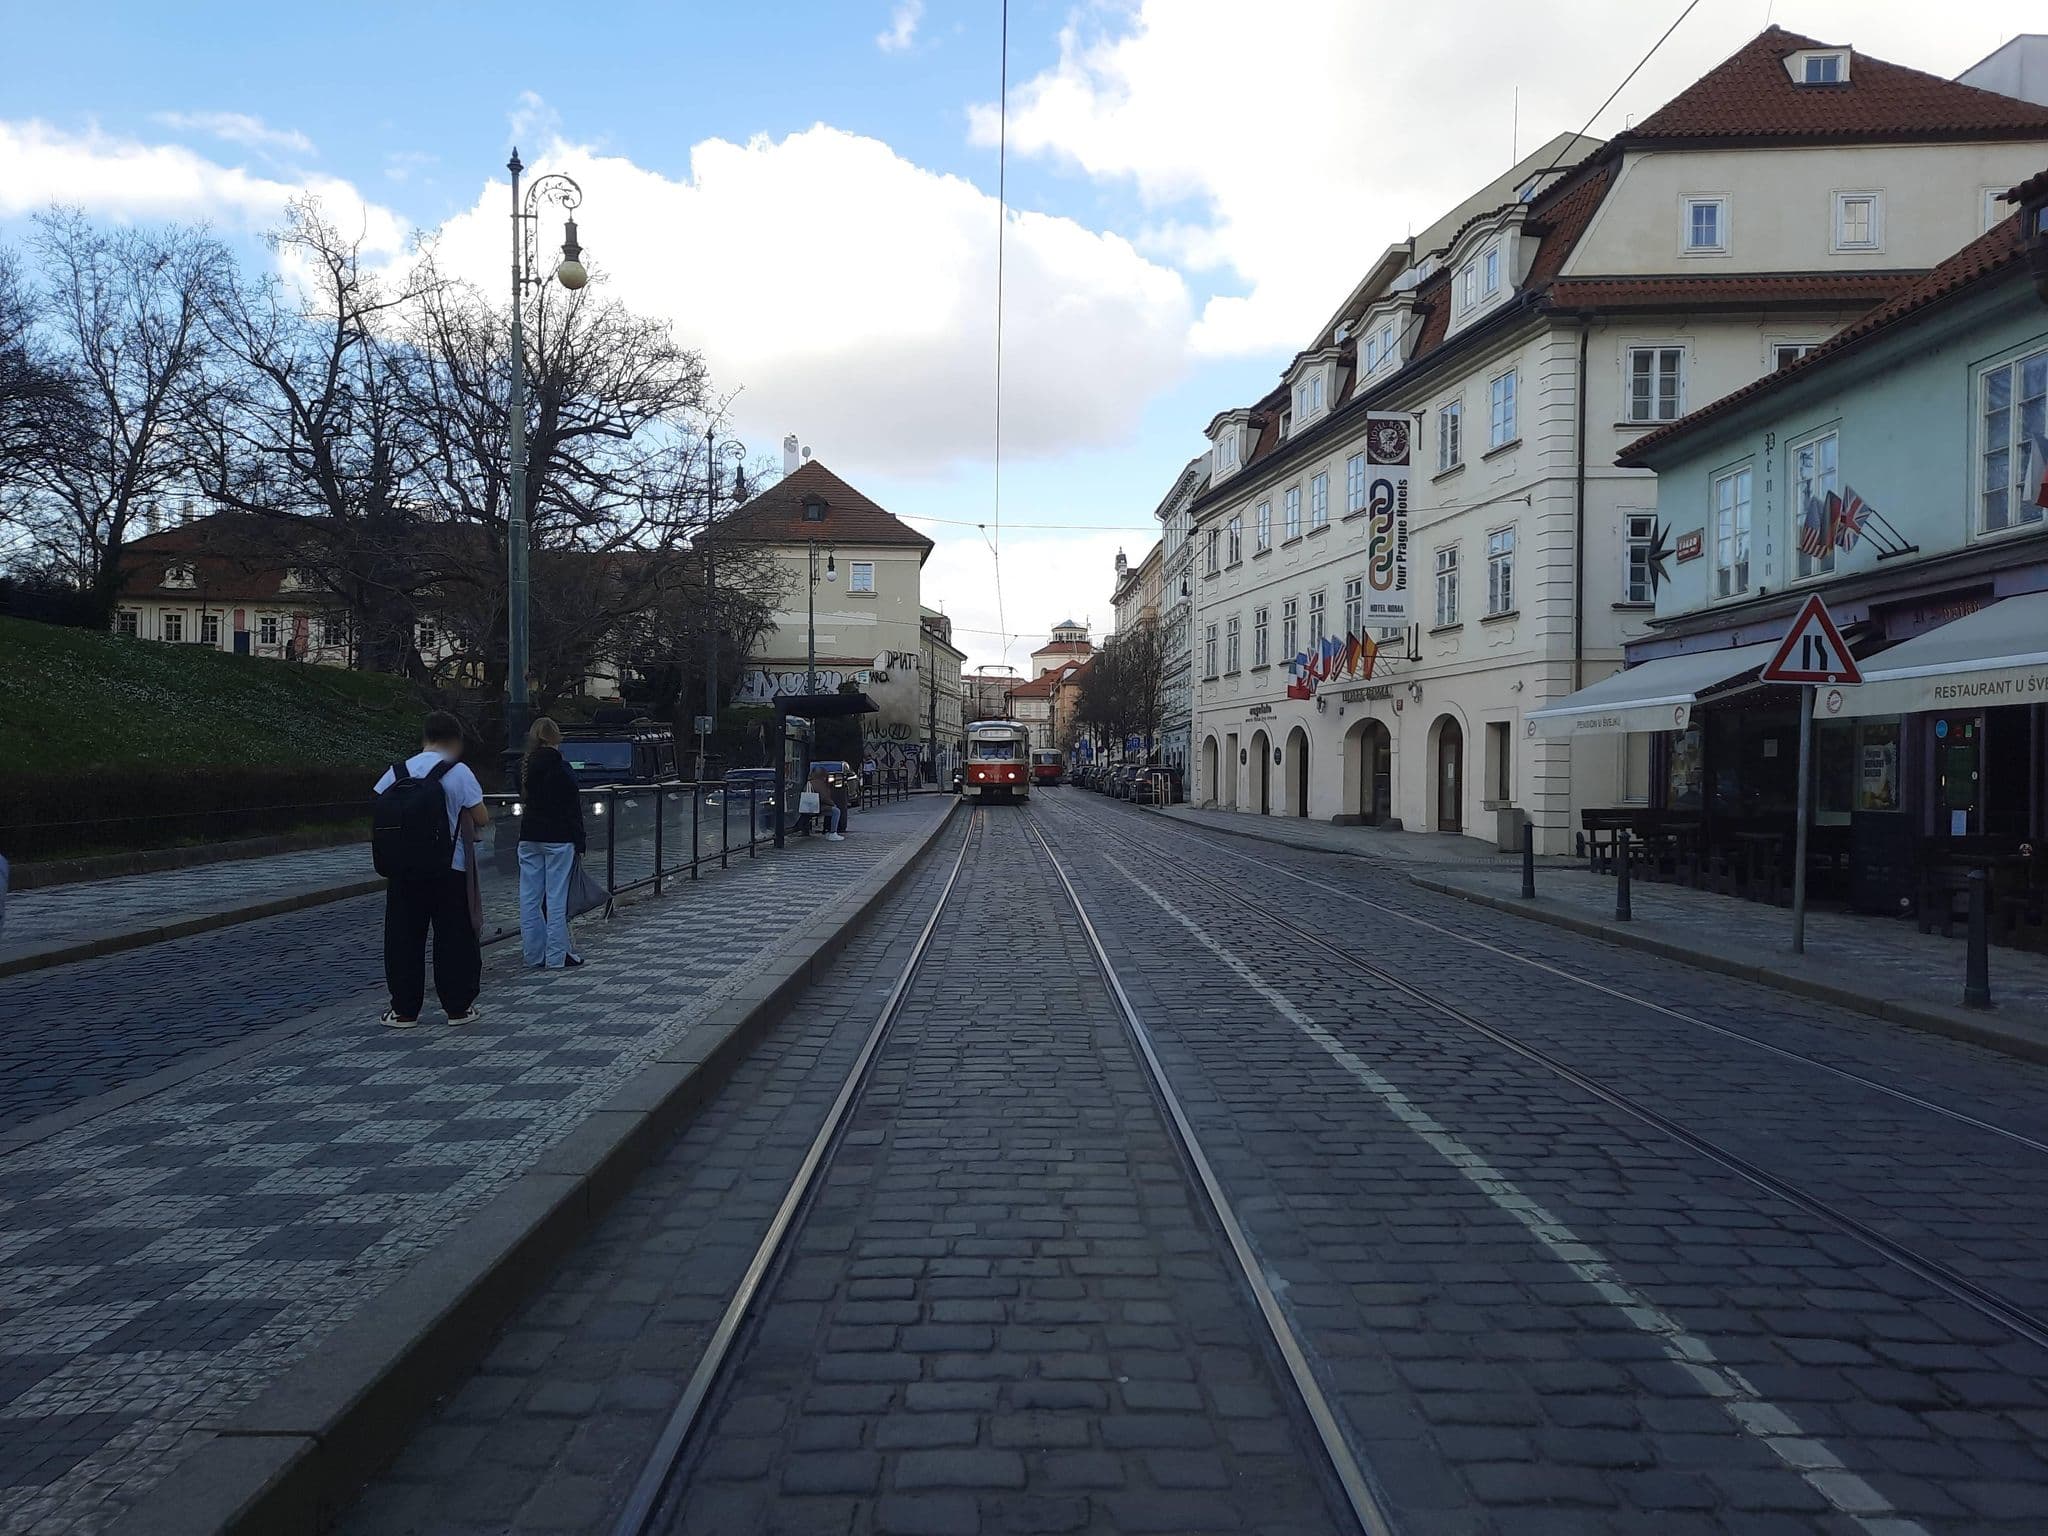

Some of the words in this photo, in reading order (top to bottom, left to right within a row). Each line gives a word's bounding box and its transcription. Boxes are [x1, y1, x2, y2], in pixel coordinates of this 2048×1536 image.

[1395, 478, 1408, 517] Hotels
[1395, 519, 1408, 563] Prague
[1395, 564, 1407, 591] Your
[1934, 680, 2012, 699] RESTAURANT
[2015, 679, 2024, 692] U
